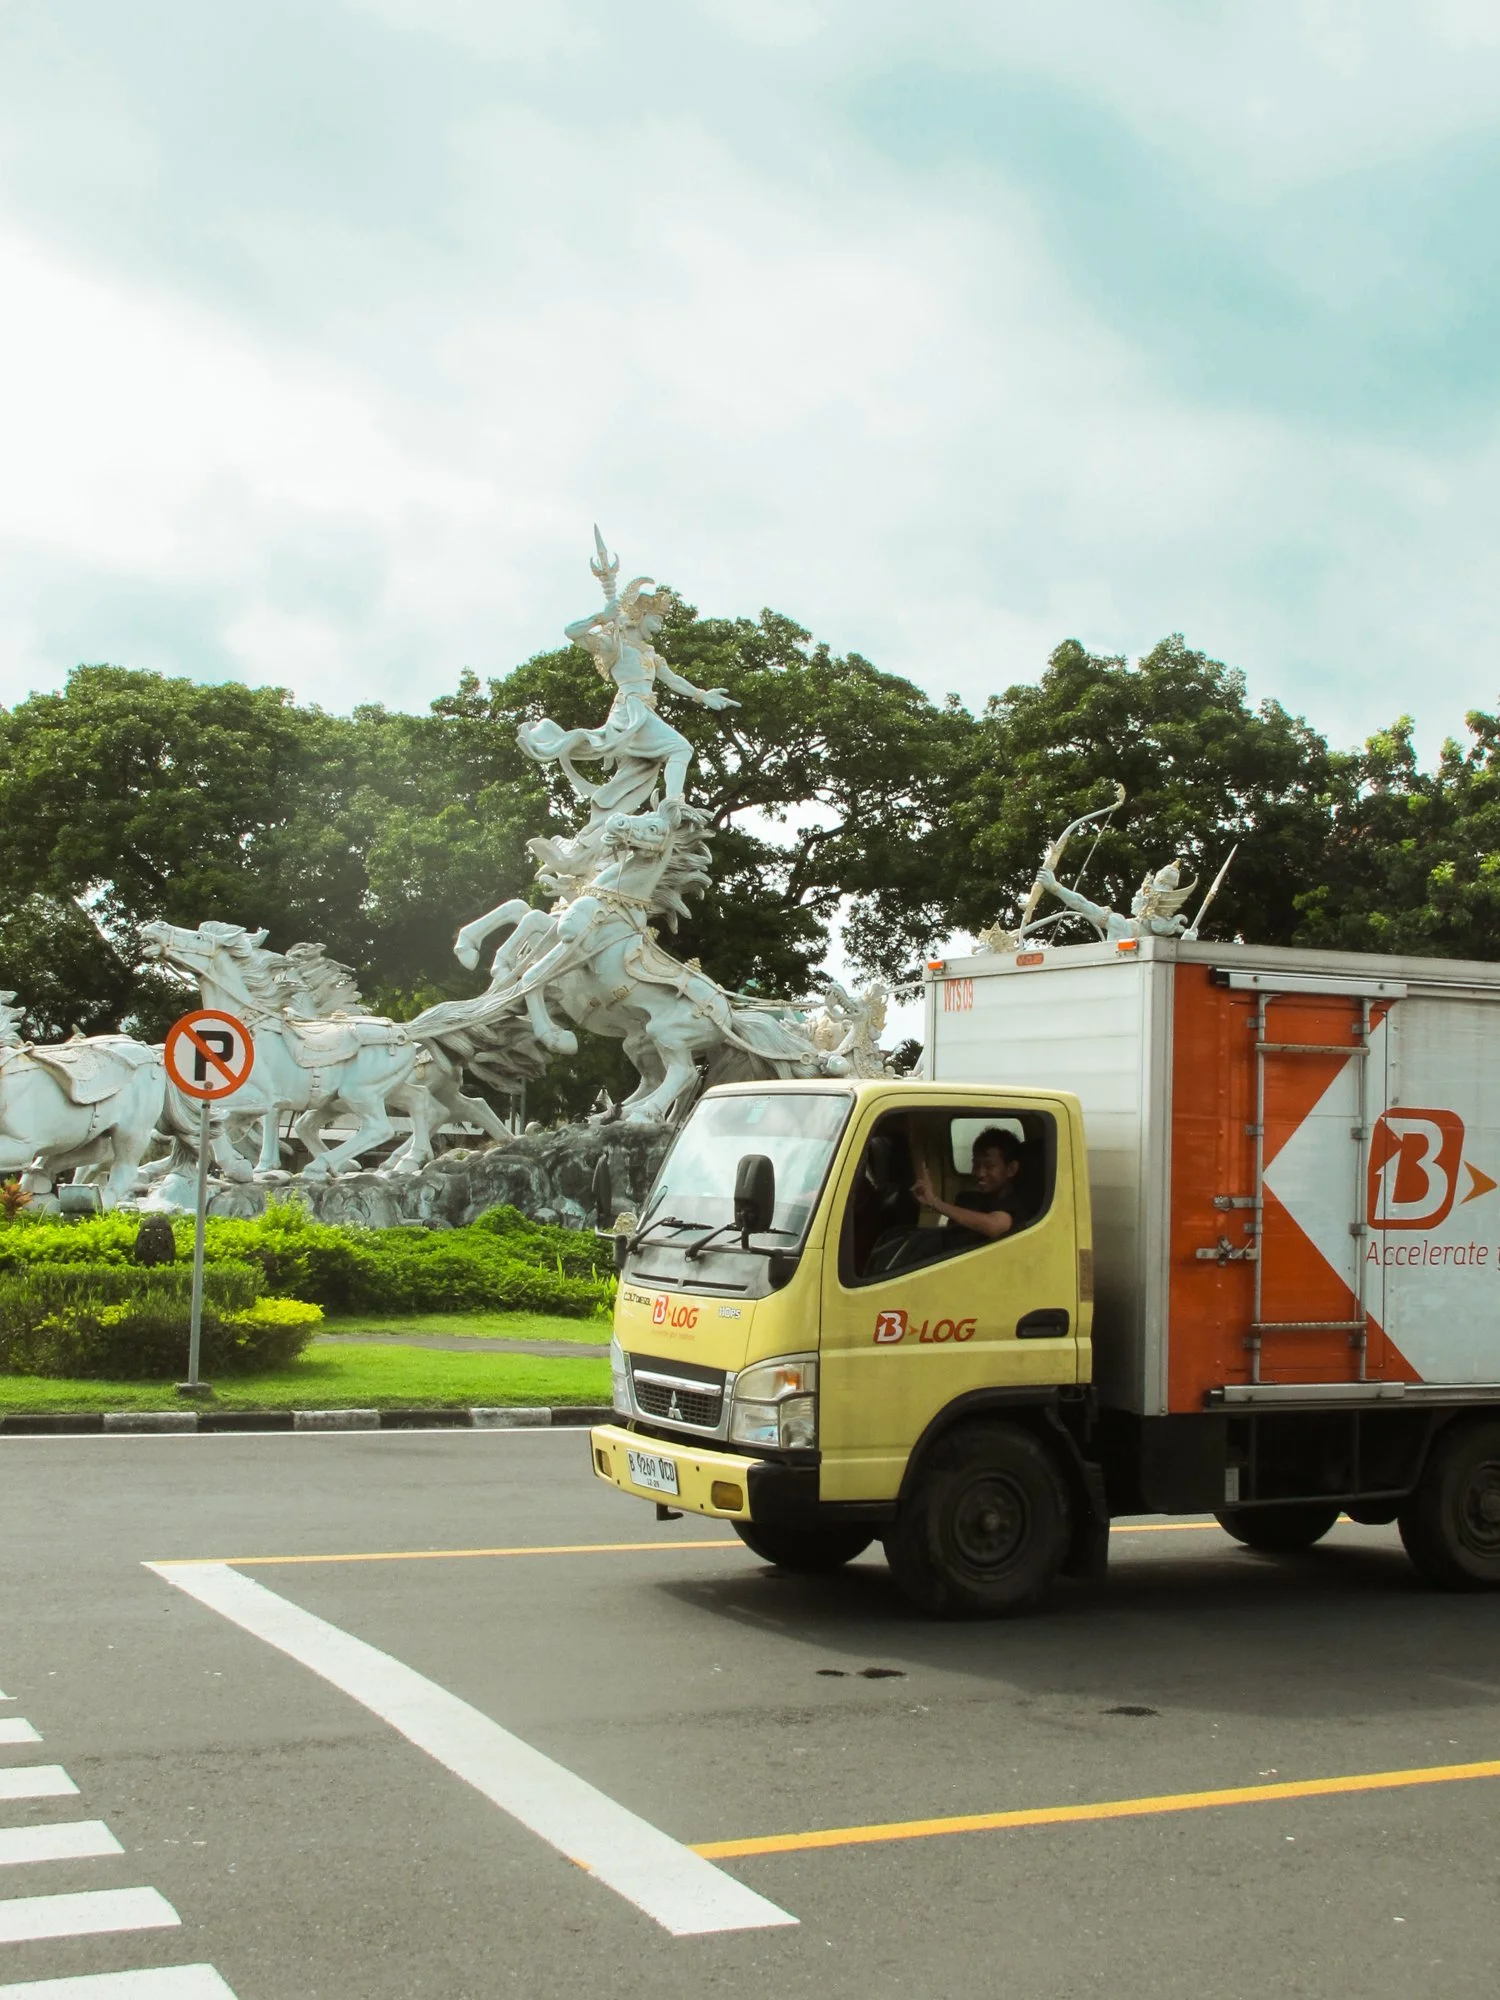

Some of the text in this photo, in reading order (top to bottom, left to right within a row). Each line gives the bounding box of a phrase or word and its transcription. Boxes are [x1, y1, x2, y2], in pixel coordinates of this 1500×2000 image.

[944, 977, 973, 1012] WTS 09
[194, 1030, 234, 1082] P
[1373, 1115, 1451, 1222] B
[1366, 1239, 1489, 1266] Accelerate
[671, 1305, 699, 1329] LOG
[919, 1318, 978, 1343] LOG
[628, 1453, 635, 1471] B
